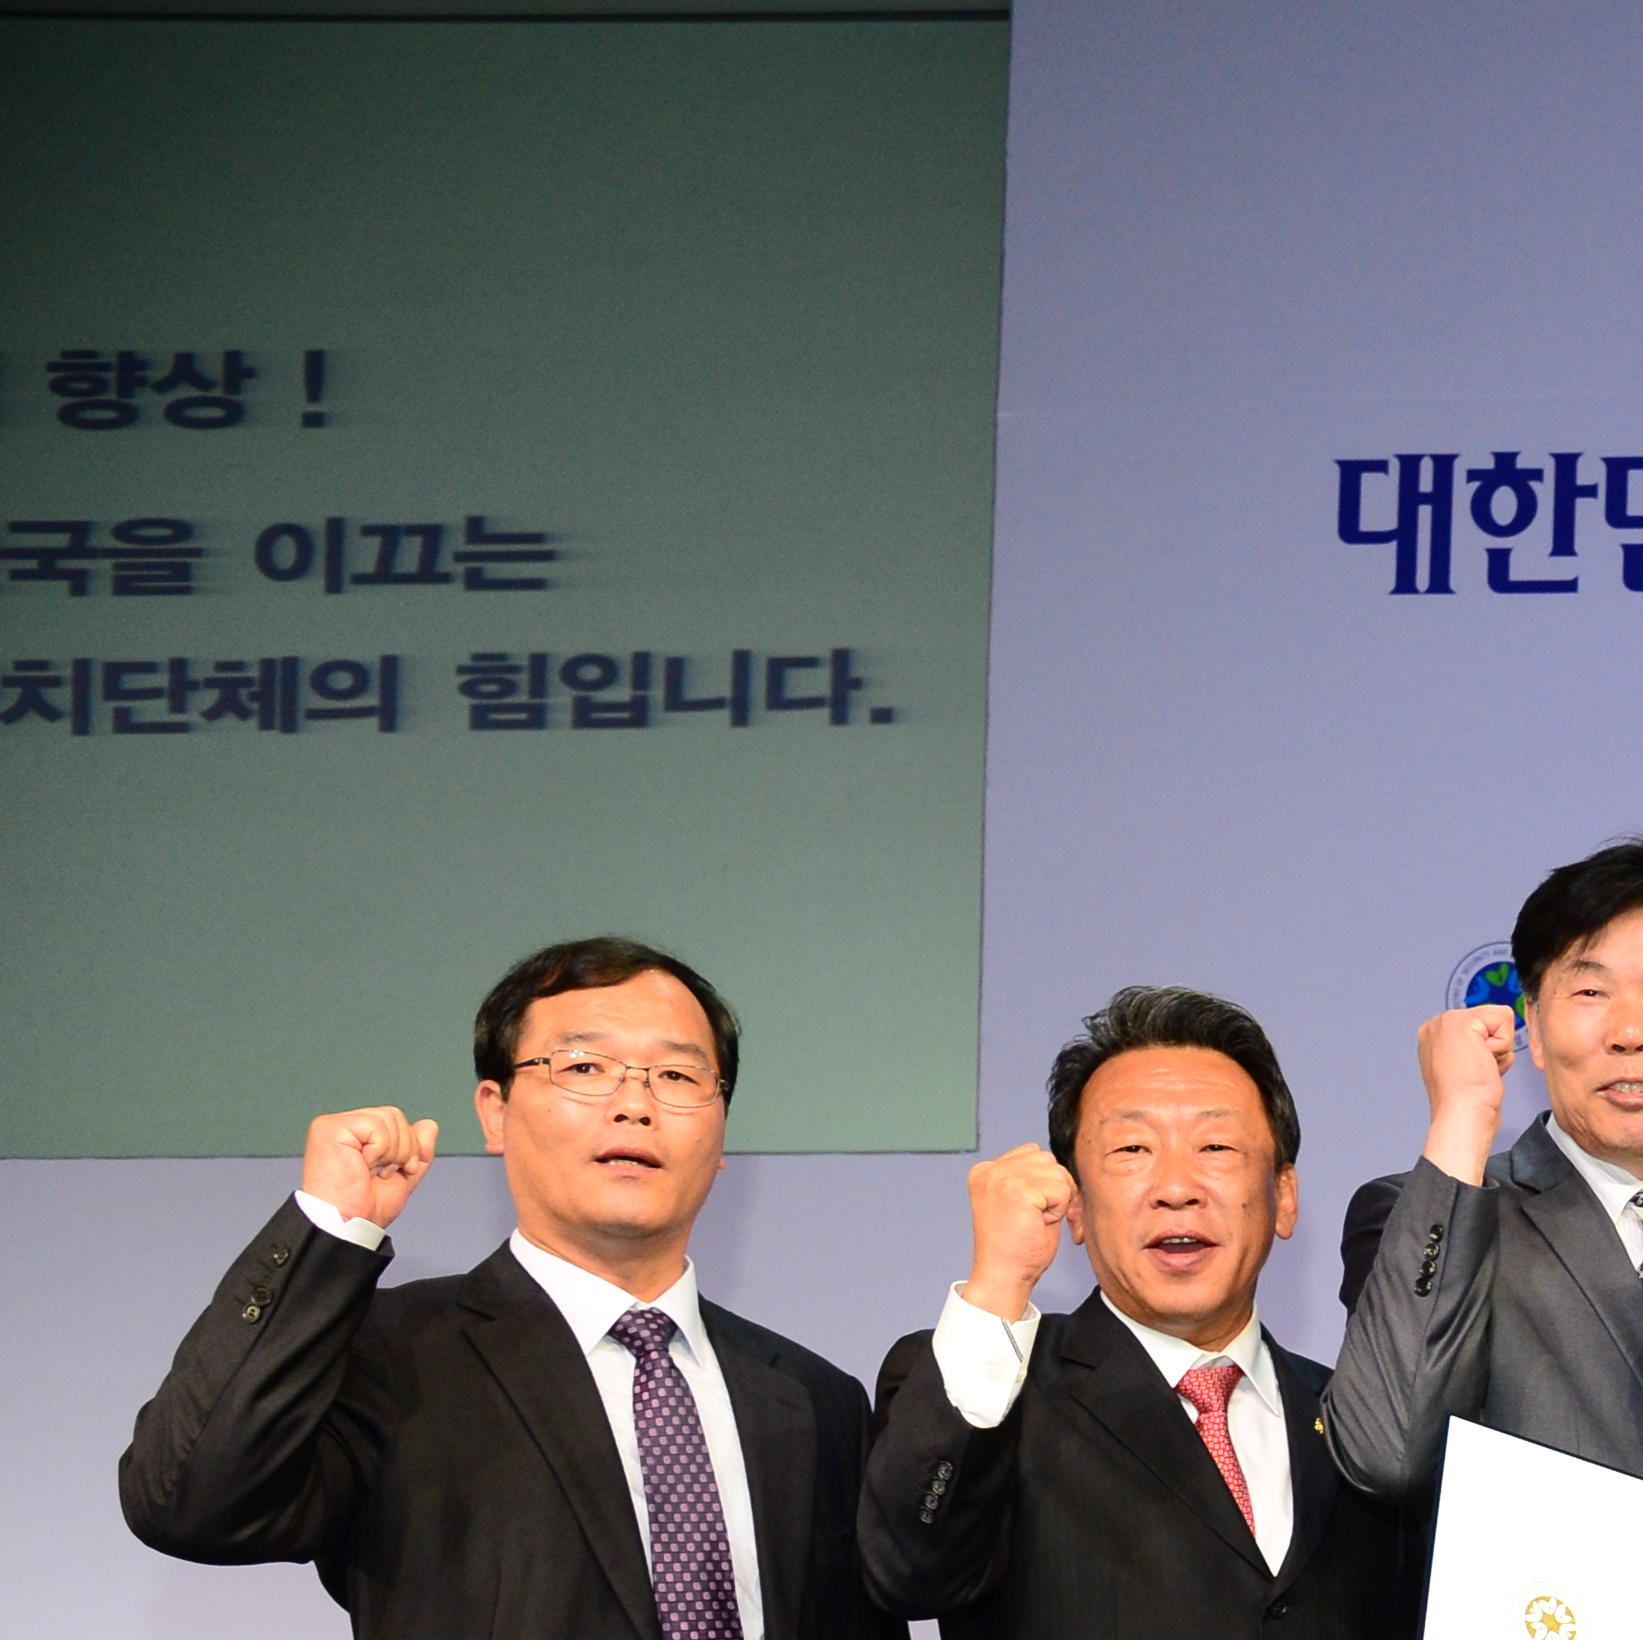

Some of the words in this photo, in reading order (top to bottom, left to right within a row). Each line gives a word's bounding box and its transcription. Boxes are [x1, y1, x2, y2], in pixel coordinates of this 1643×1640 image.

[44, 348, 257, 431] 향상
[0, 517, 204, 597] 국을
[254, 515, 560, 595] 이끄는
[0, 655, 400, 737] 치단체의
[455, 647, 895, 731] 힘입니다.
